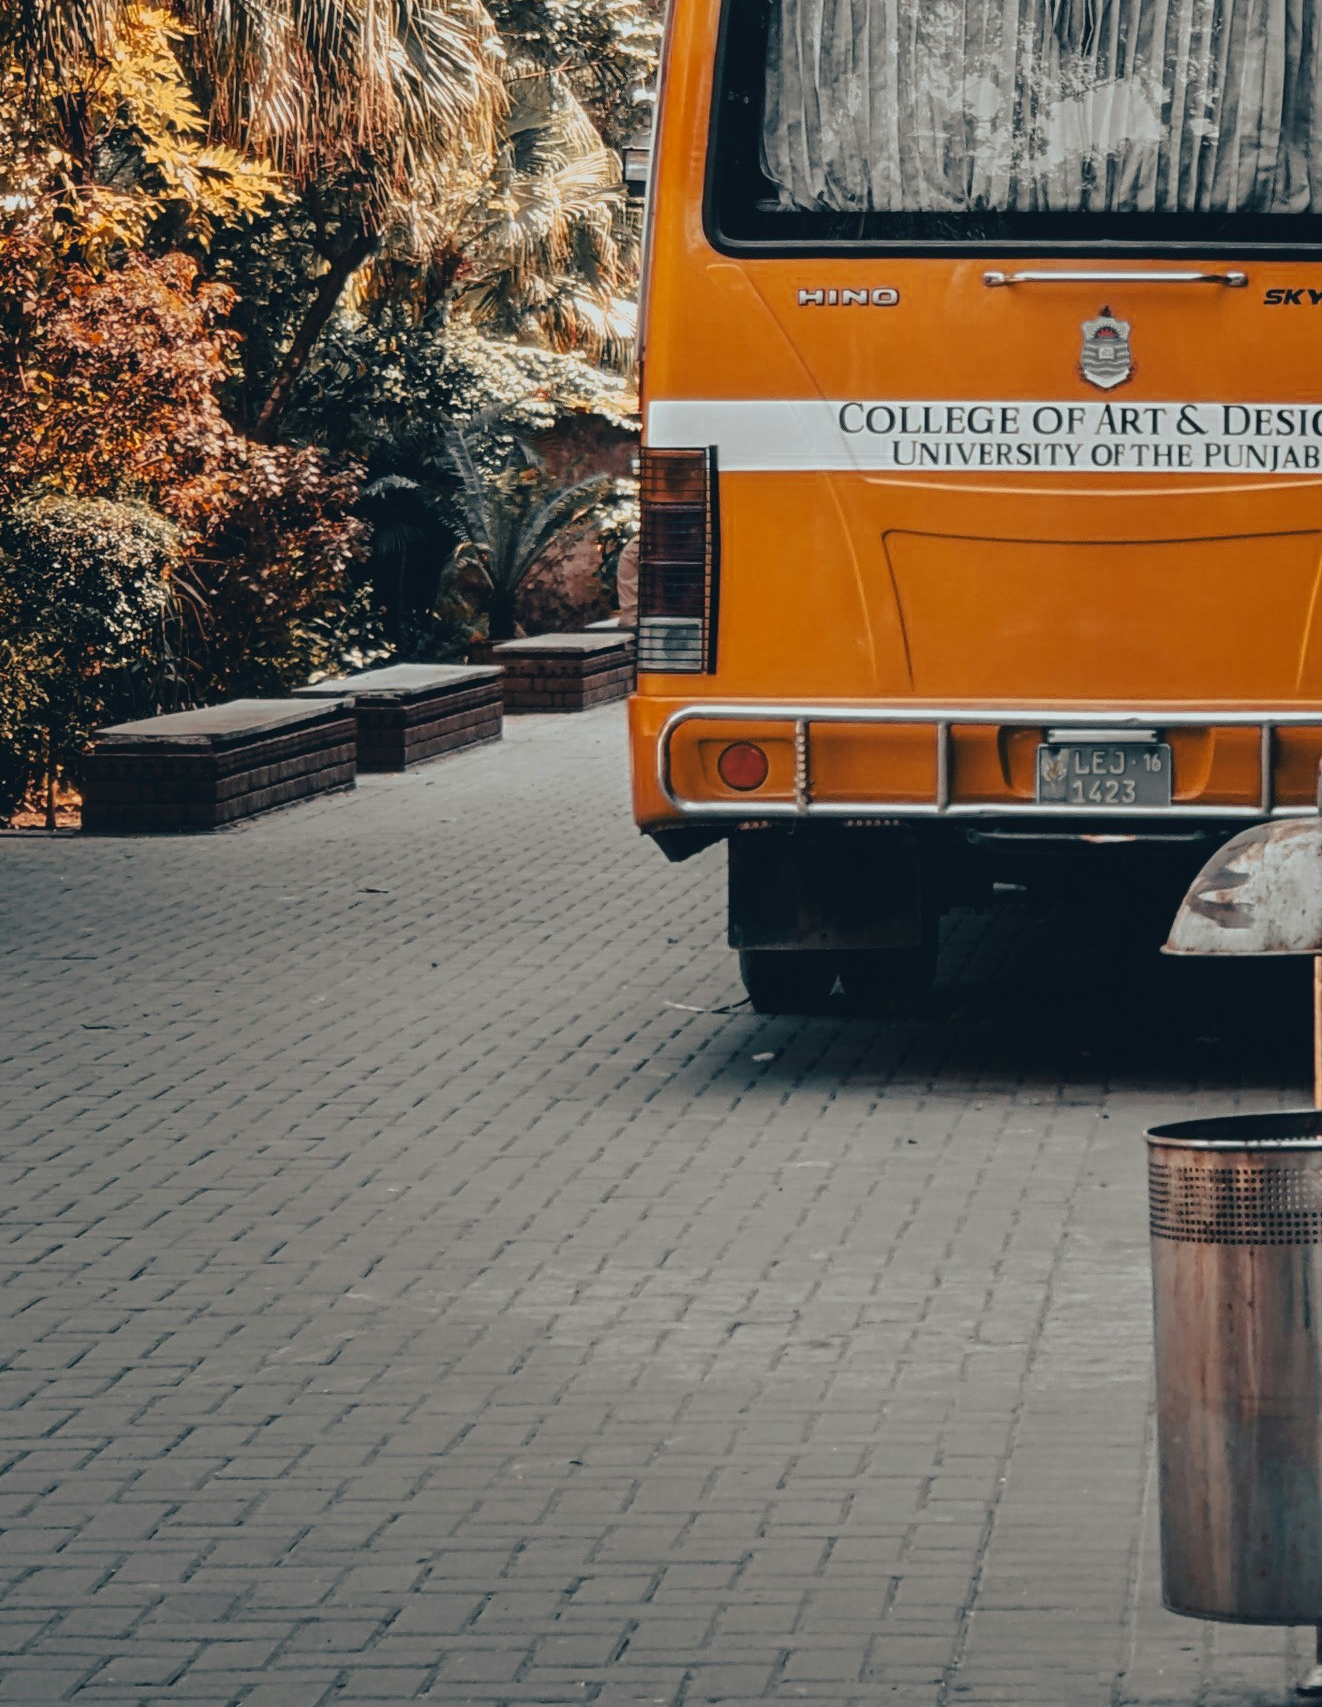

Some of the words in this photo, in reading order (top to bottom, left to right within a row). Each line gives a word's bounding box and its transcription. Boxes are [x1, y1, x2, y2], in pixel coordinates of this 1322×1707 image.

[797, 287, 900, 307] HINO
[838, 402, 1020, 435] COLLEGE
[1032, 405, 1087, 435] OF
[1095, 403, 1167, 436] ART
[1176, 404, 1209, 436] &
[892, 440, 1084, 466] UNIVERSITY
[1090, 443, 1126, 467] OF
[1130, 444, 1194, 467] THE
[1203, 443, 1321, 472] PUNJAB
[1074, 751, 1126, 775] LEJ
[1143, 753, 1163, 773] 16
[1072, 780, 1137, 804] 1423
